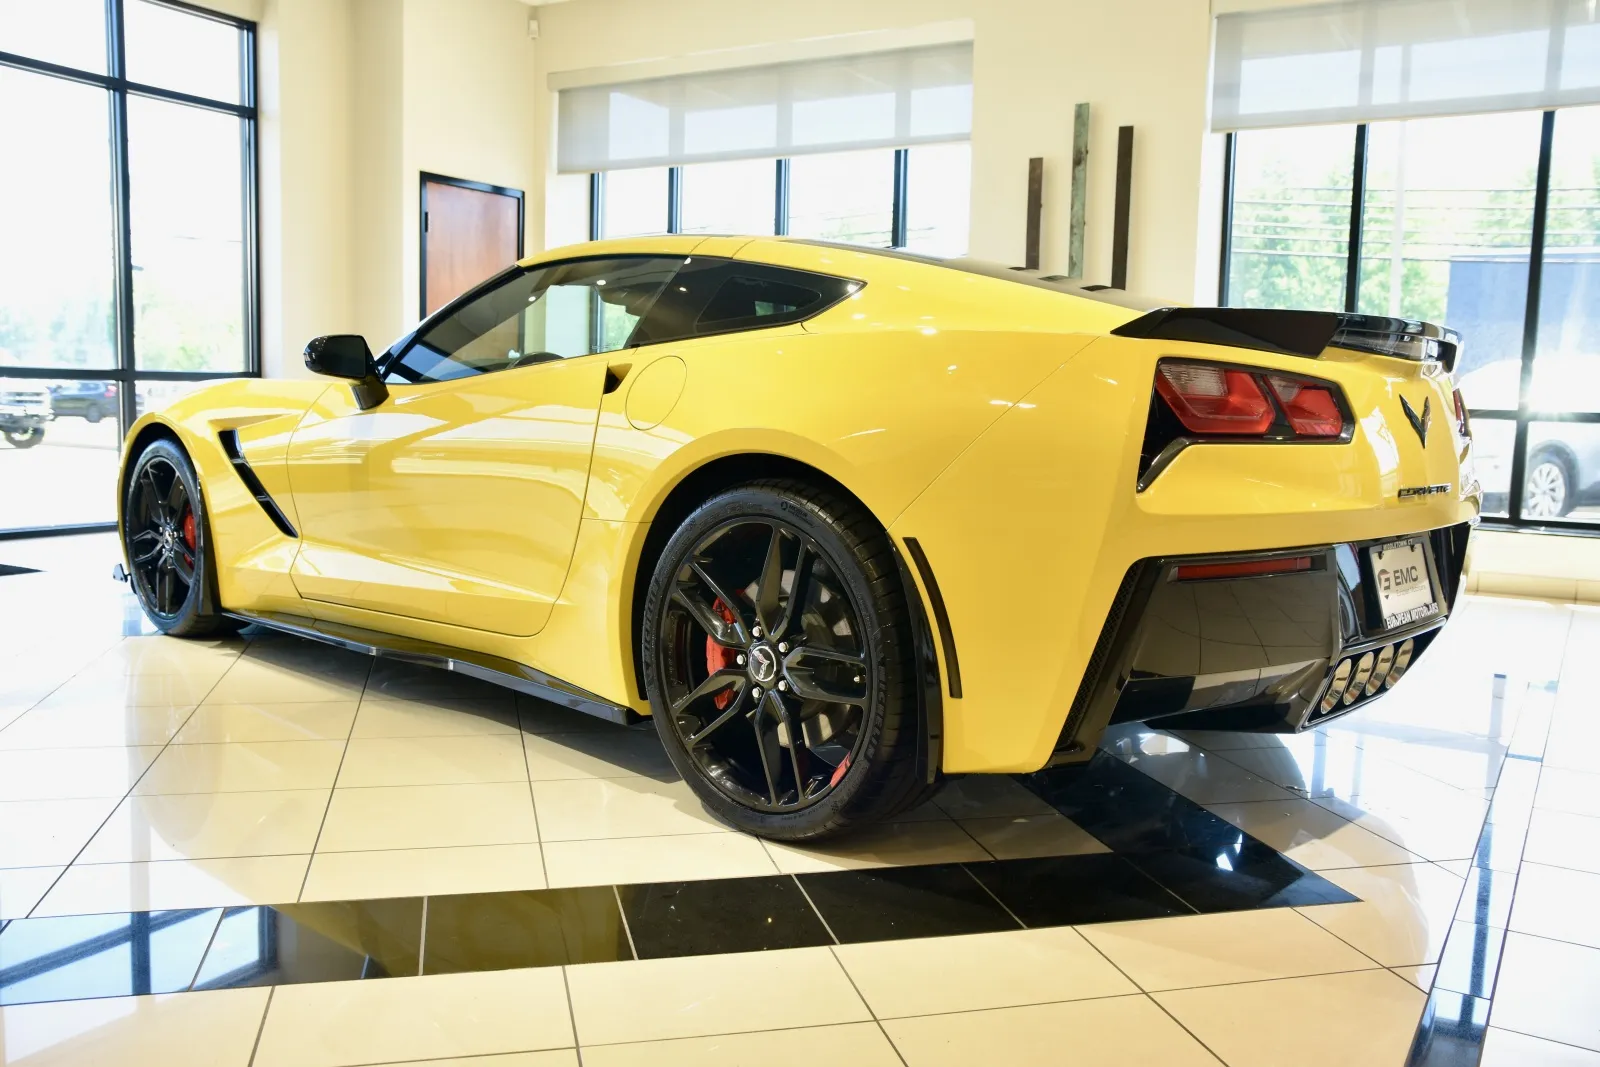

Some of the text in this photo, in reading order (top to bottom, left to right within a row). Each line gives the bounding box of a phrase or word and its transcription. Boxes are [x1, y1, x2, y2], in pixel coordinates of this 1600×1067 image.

[1398, 484, 1450, 497] CORVETTE
[1393, 565, 1418, 586] EMC
[1386, 609, 1411, 629] EUROPEAN
